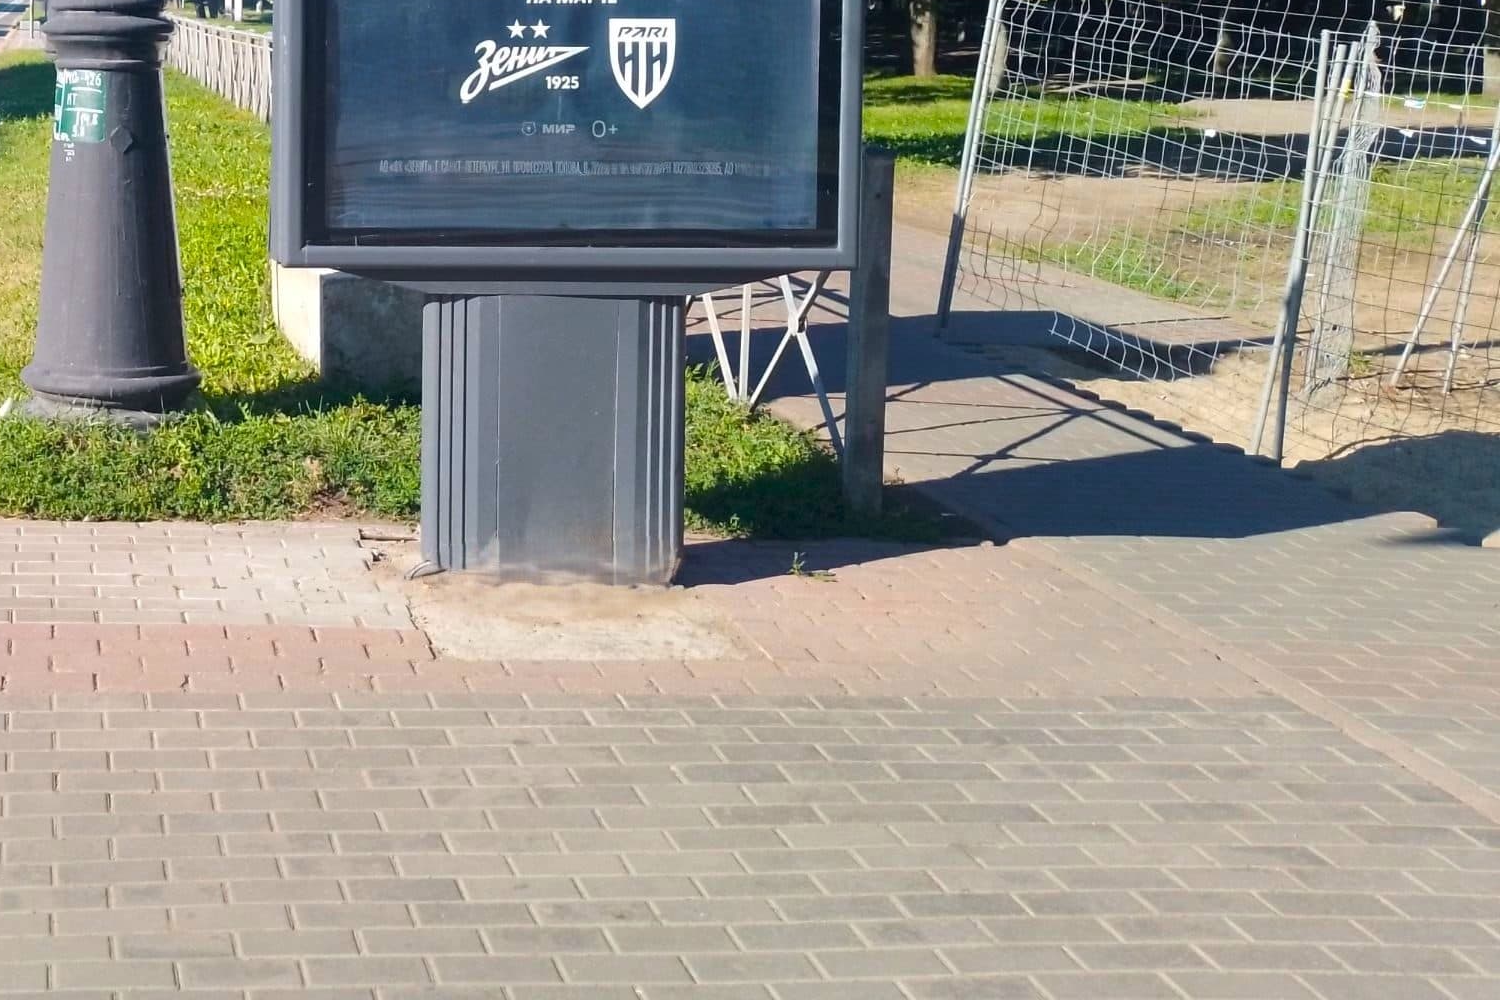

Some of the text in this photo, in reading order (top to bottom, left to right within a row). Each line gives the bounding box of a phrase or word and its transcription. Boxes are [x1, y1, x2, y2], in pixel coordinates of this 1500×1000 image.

[460, 39, 590, 104] Зенит
[546, 76, 580, 90] 1925
[542, 124, 576, 134] МИР
[592, 120, 618, 138] 0+
